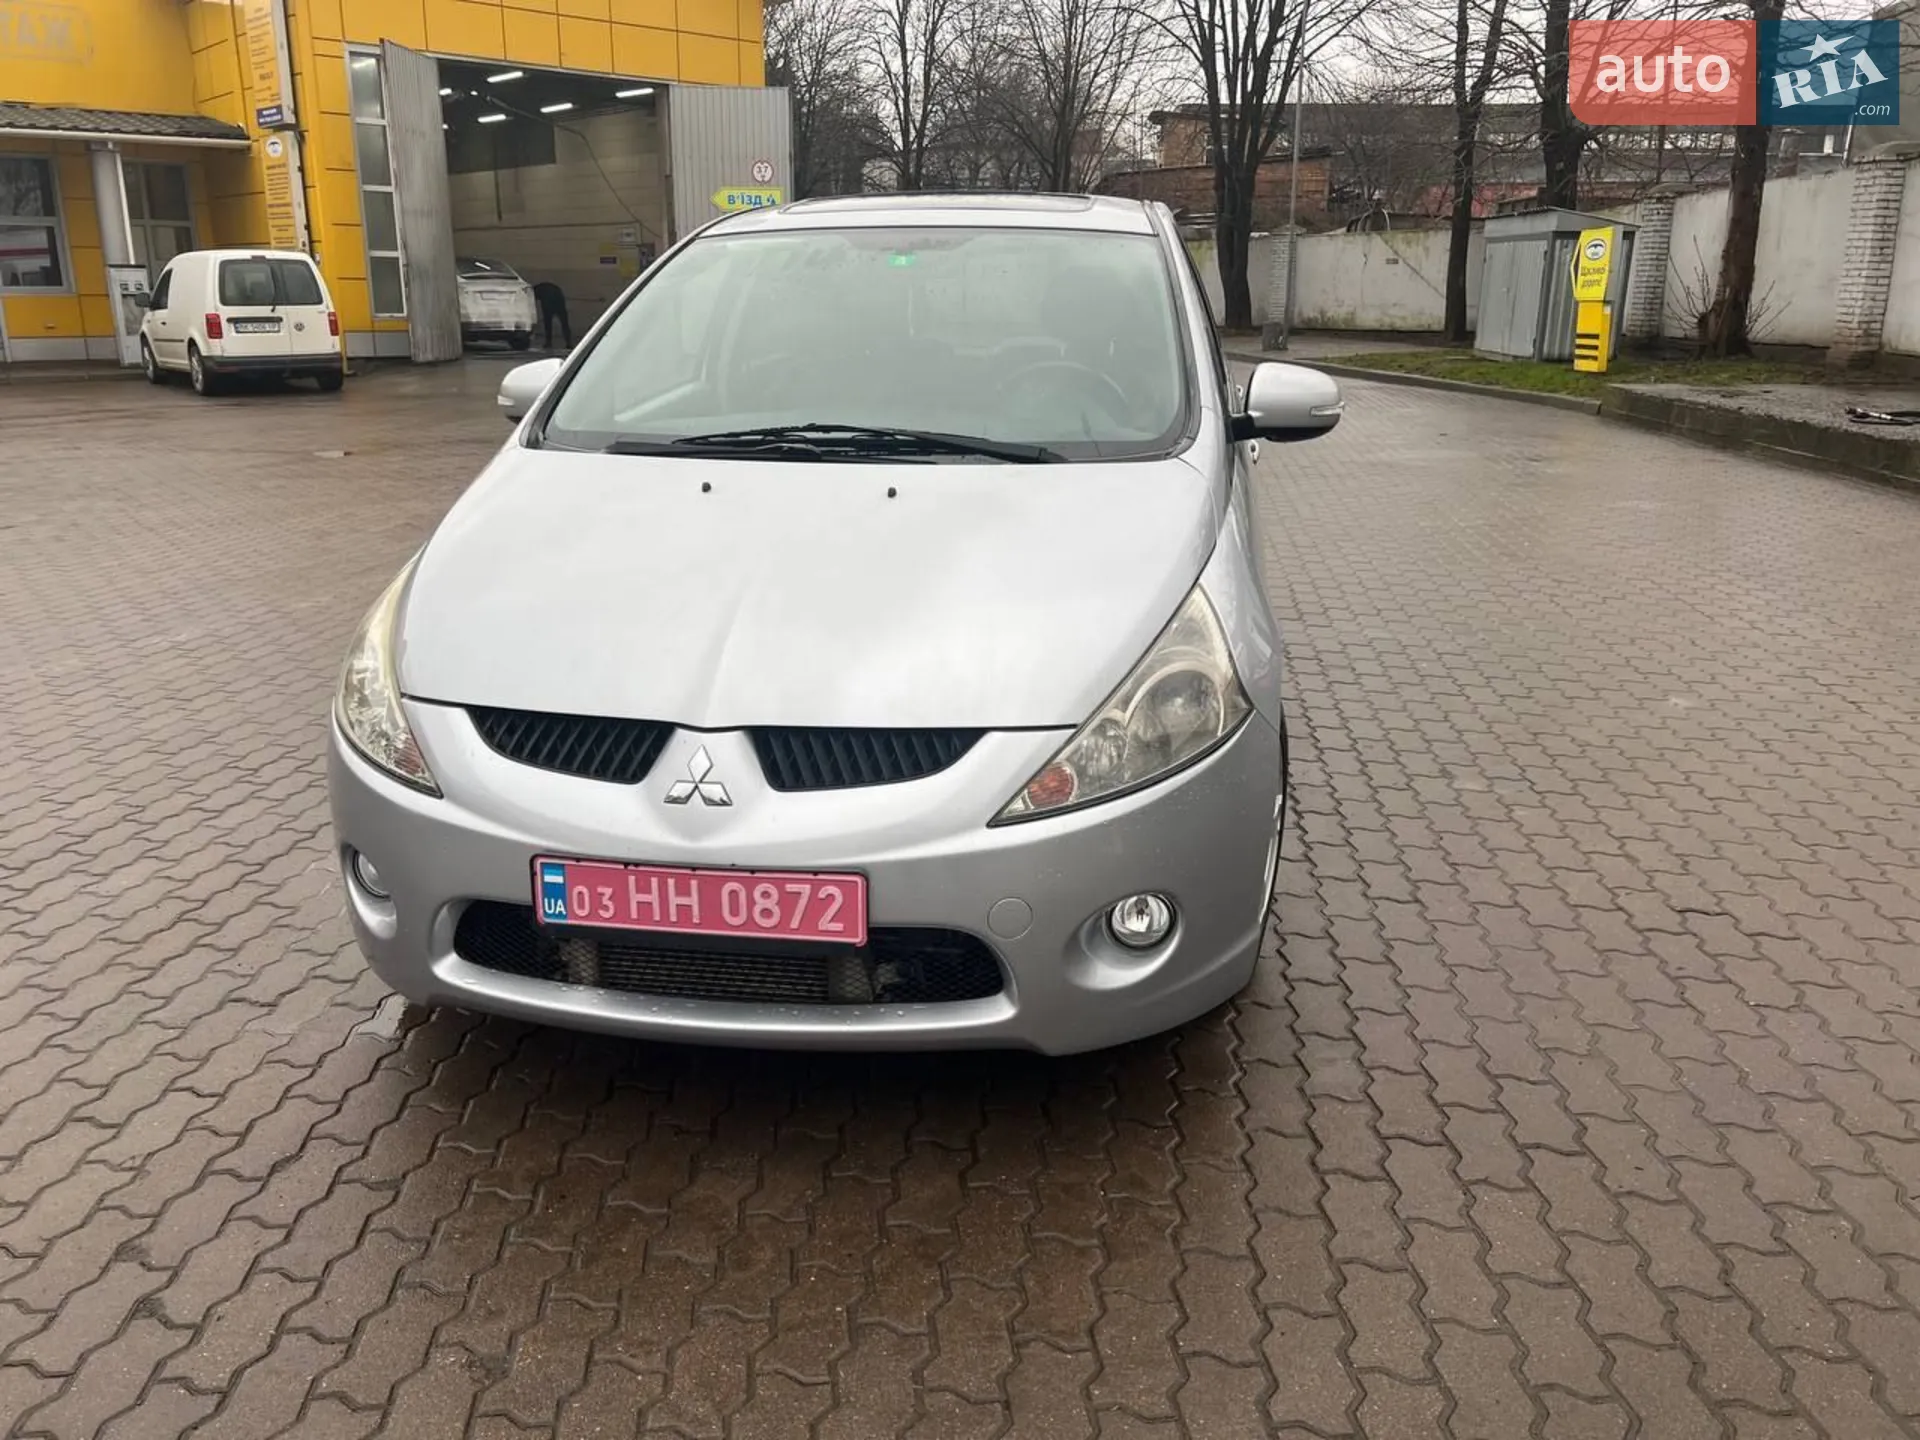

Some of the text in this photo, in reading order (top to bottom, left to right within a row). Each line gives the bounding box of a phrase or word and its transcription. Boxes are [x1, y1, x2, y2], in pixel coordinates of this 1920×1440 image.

[544, 875, 844, 931] UA 03 HH 0872
